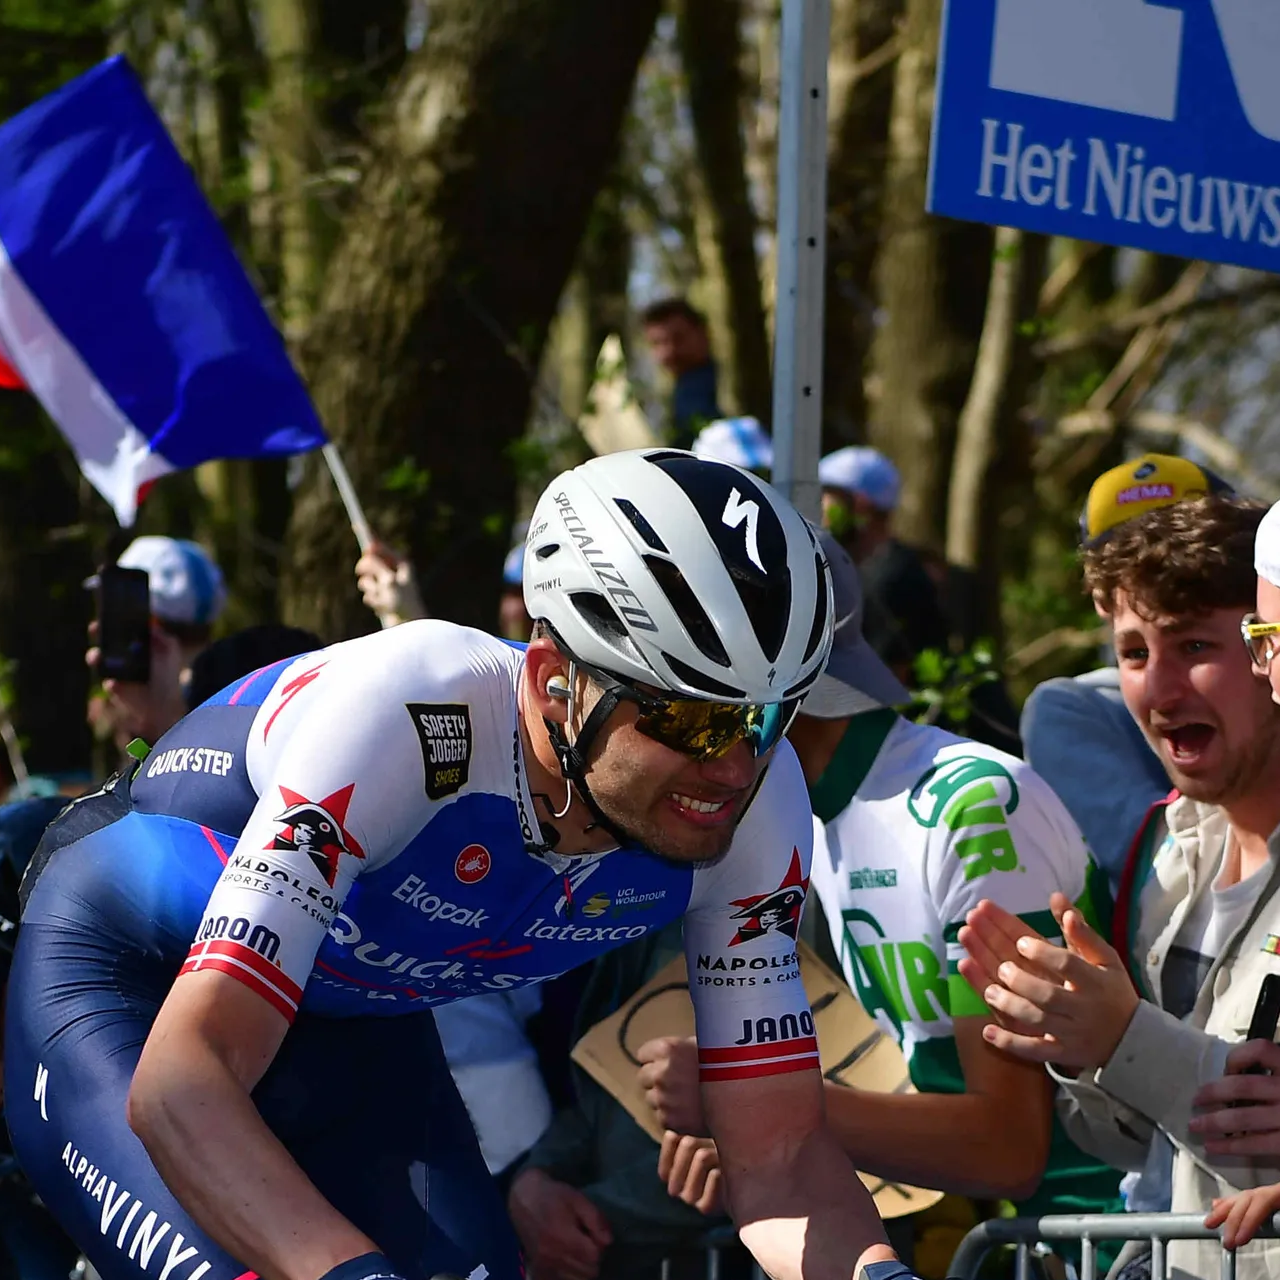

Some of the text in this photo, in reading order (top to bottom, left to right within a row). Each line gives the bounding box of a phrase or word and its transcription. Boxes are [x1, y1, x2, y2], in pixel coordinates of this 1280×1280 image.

[976, 118, 1076, 210] Het
[1119, 485, 1171, 503] HEMA
[553, 492, 658, 632] SPECIALIZED
[420, 714, 466, 737] SAFETY
[428, 739, 467, 763] JOGGER
[434, 768, 460, 787] SHOES
[229, 855, 343, 917] NAPOLEON
[615, 890, 667, 906] WORLDTOUR
[617, 888, 634, 897] UCI
[222, 874, 272, 891] SPORTS
[290, 896, 332, 929] CASINO
[392, 874, 489, 929] Ekopak
[523, 918, 648, 942] latexco
[697, 976, 757, 987] SPORTS
[734, 1010, 816, 1045] JANO
